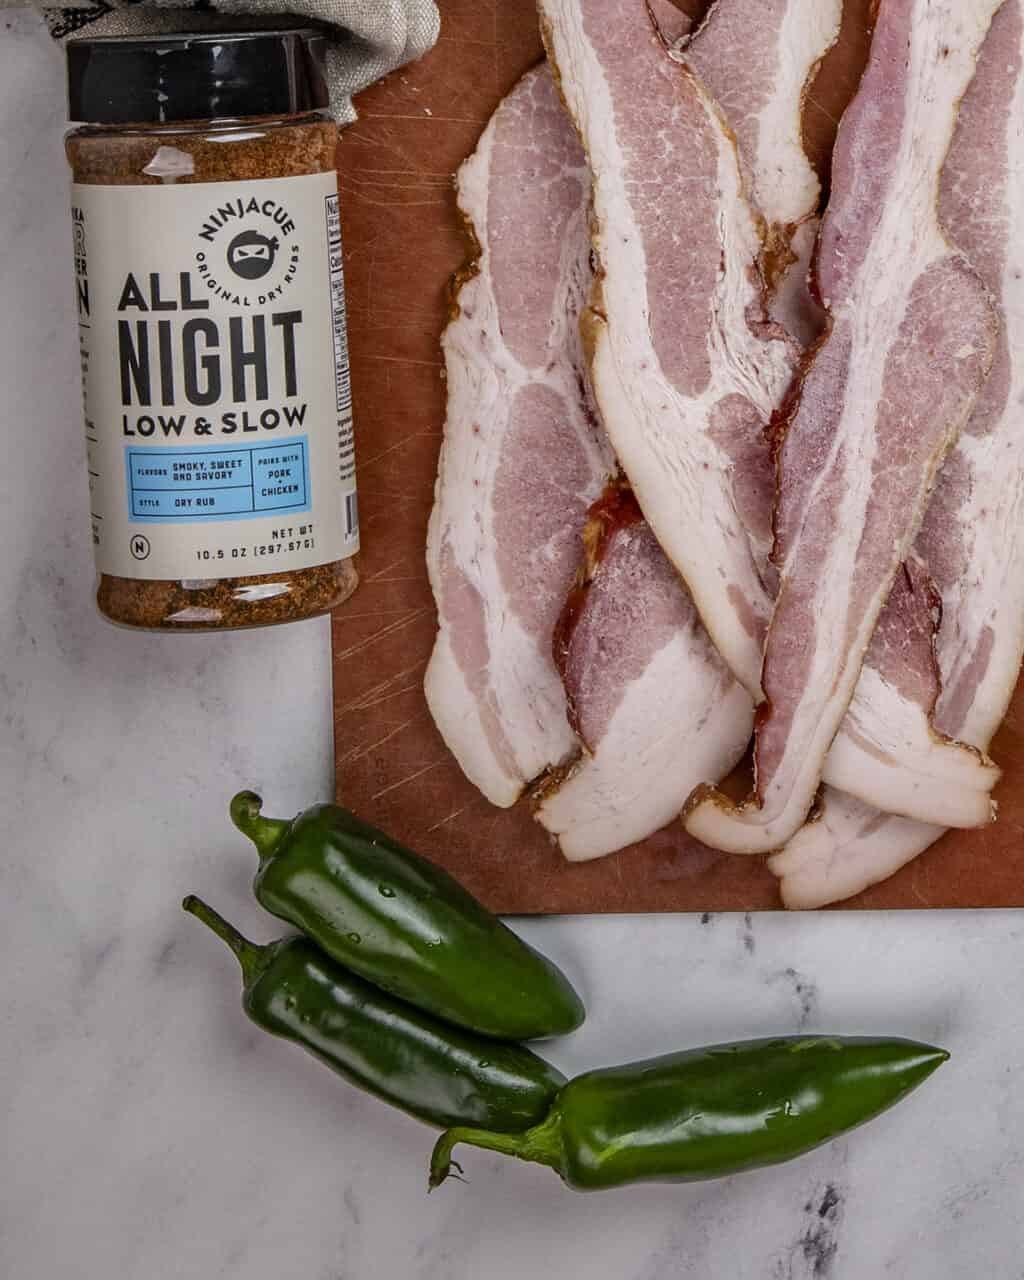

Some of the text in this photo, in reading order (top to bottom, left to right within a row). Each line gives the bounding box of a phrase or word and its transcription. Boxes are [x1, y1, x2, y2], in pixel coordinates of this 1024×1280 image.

[198, 196, 296, 242] NINJACUE
[196, 252, 250, 306] ORIGINAL
[258, 285, 283, 305] DRY
[284, 245, 299, 284] RUBS
[117, 271, 209, 312] ALL
[117, 309, 302, 407] NIGHT
[123, 404, 308, 437] LOW & SLOW
[210, 459, 243, 470] SWEET
[282, 455, 299, 463] WITH
[173, 471, 233, 481] AND SAVORY
[268, 469, 291, 478] PORK
[261, 485, 299, 497] CHICKEN
[174, 499, 192, 507] DRY
[196, 497, 215, 506] RUB
[272, 524, 314, 539] NET WT
[197, 551, 224, 561] 10.5
[231, 548, 247, 558] OZ
